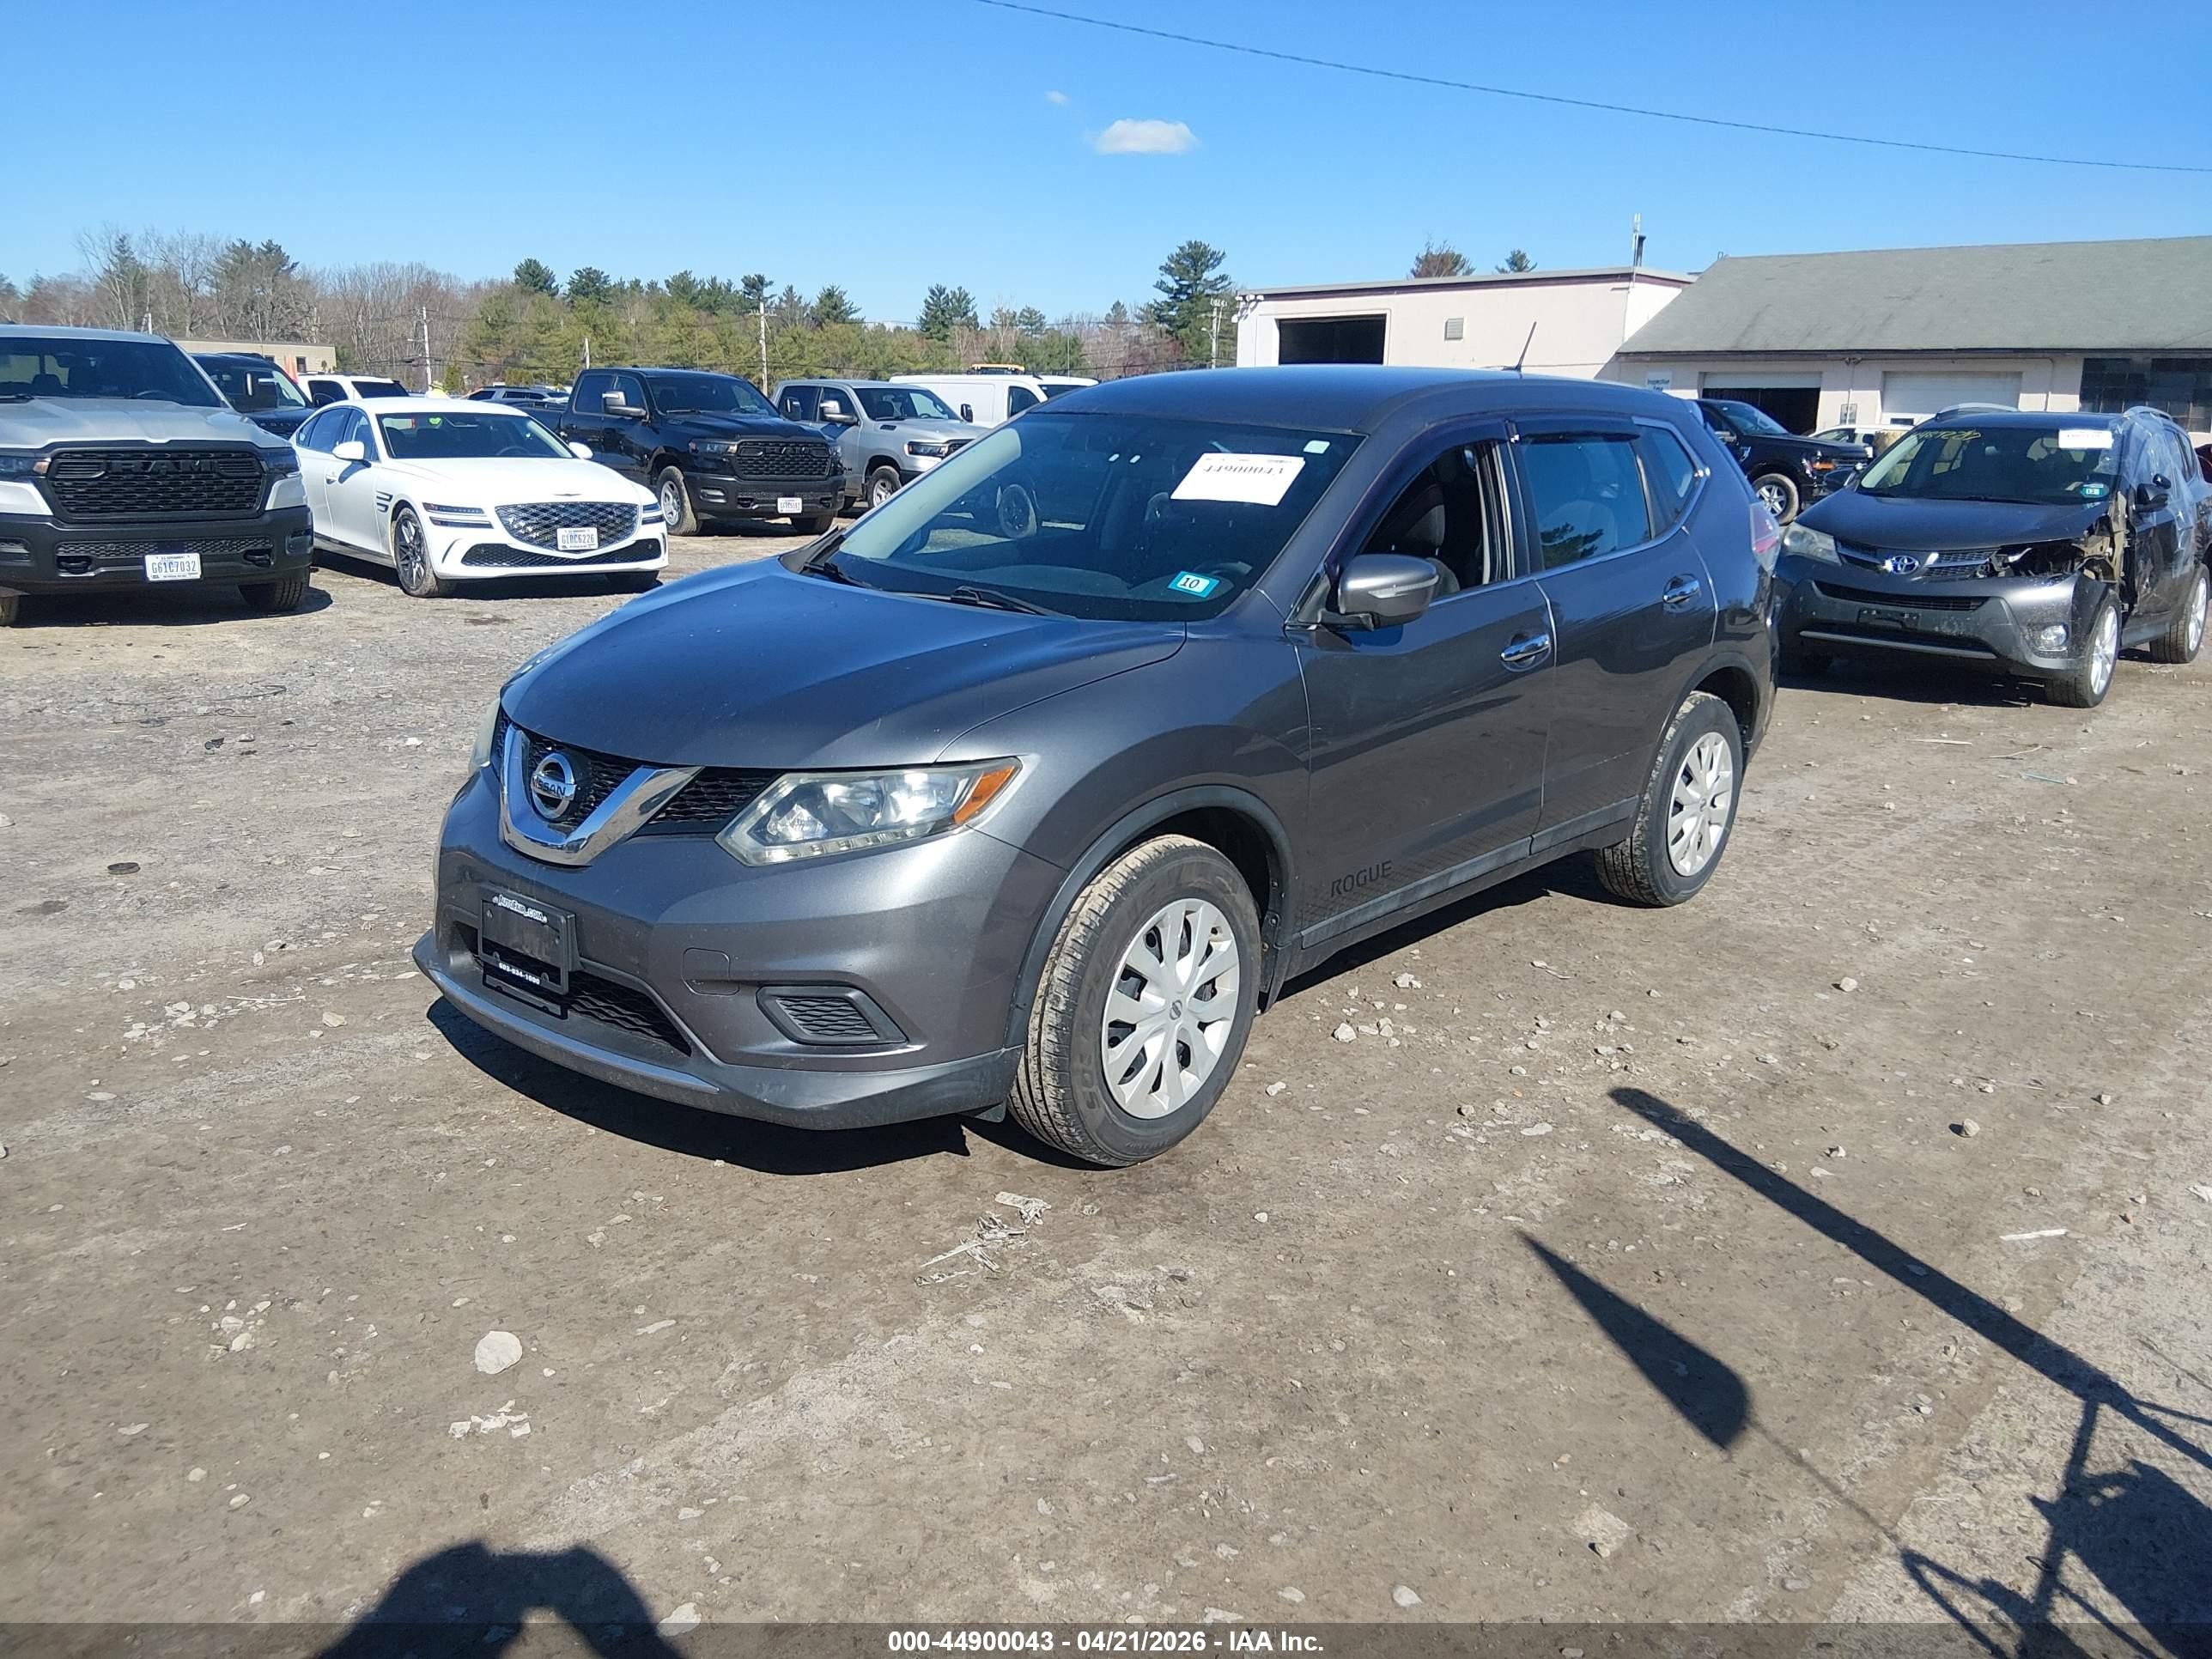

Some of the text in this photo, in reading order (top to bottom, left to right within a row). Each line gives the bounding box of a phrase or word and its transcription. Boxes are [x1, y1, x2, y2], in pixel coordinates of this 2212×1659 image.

[111, 459, 214, 473] RAM
[151, 560, 197, 574] G61C7032
[1179, 577, 1200, 589] 10
[532, 775, 567, 797] NISSAN
[1331, 860, 1392, 897] ROGUE
